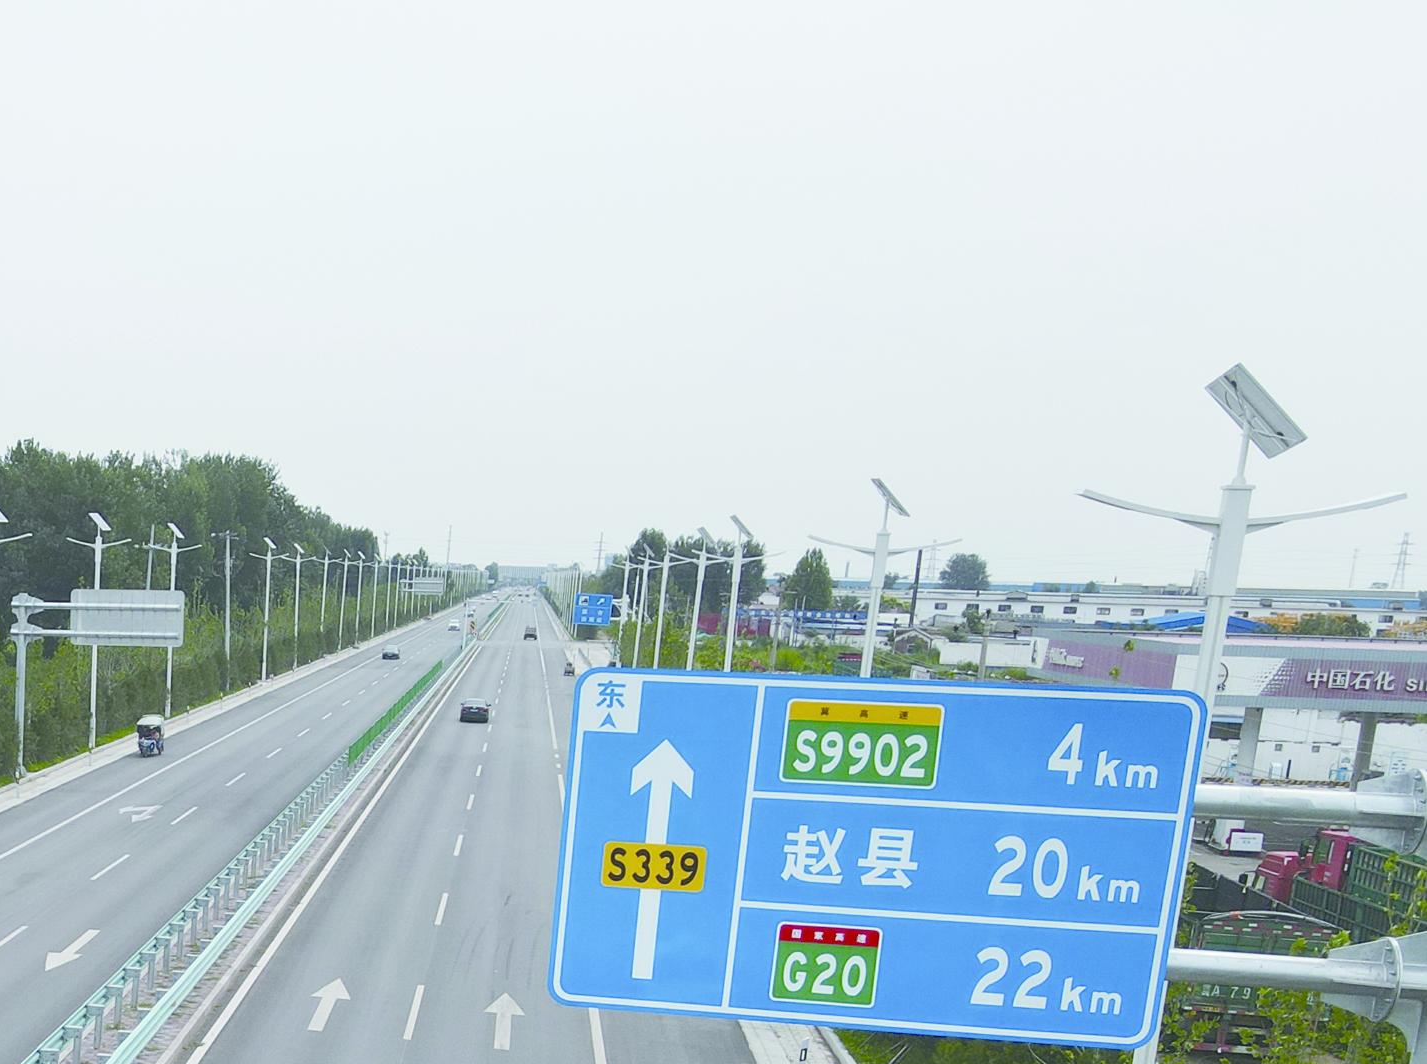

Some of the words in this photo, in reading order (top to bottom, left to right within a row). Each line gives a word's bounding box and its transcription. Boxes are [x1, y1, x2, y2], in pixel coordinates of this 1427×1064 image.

[596, 680, 626, 708] 东
[1306, 668, 1395, 691] 中国石化
[1405, 678, 1427, 691] SI
[792, 729, 928, 778] S9902
[1048, 723, 1083, 785] 4
[1094, 750, 1158, 789] km
[608, 847, 699, 886] S339
[780, 825, 918, 889] 赵县
[988, 836, 1068, 898] 20
[1077, 865, 1140, 904] km
[783, 951, 867, 996] G20
[970, 947, 1052, 1009] 22
[1061, 977, 1122, 1015] km
